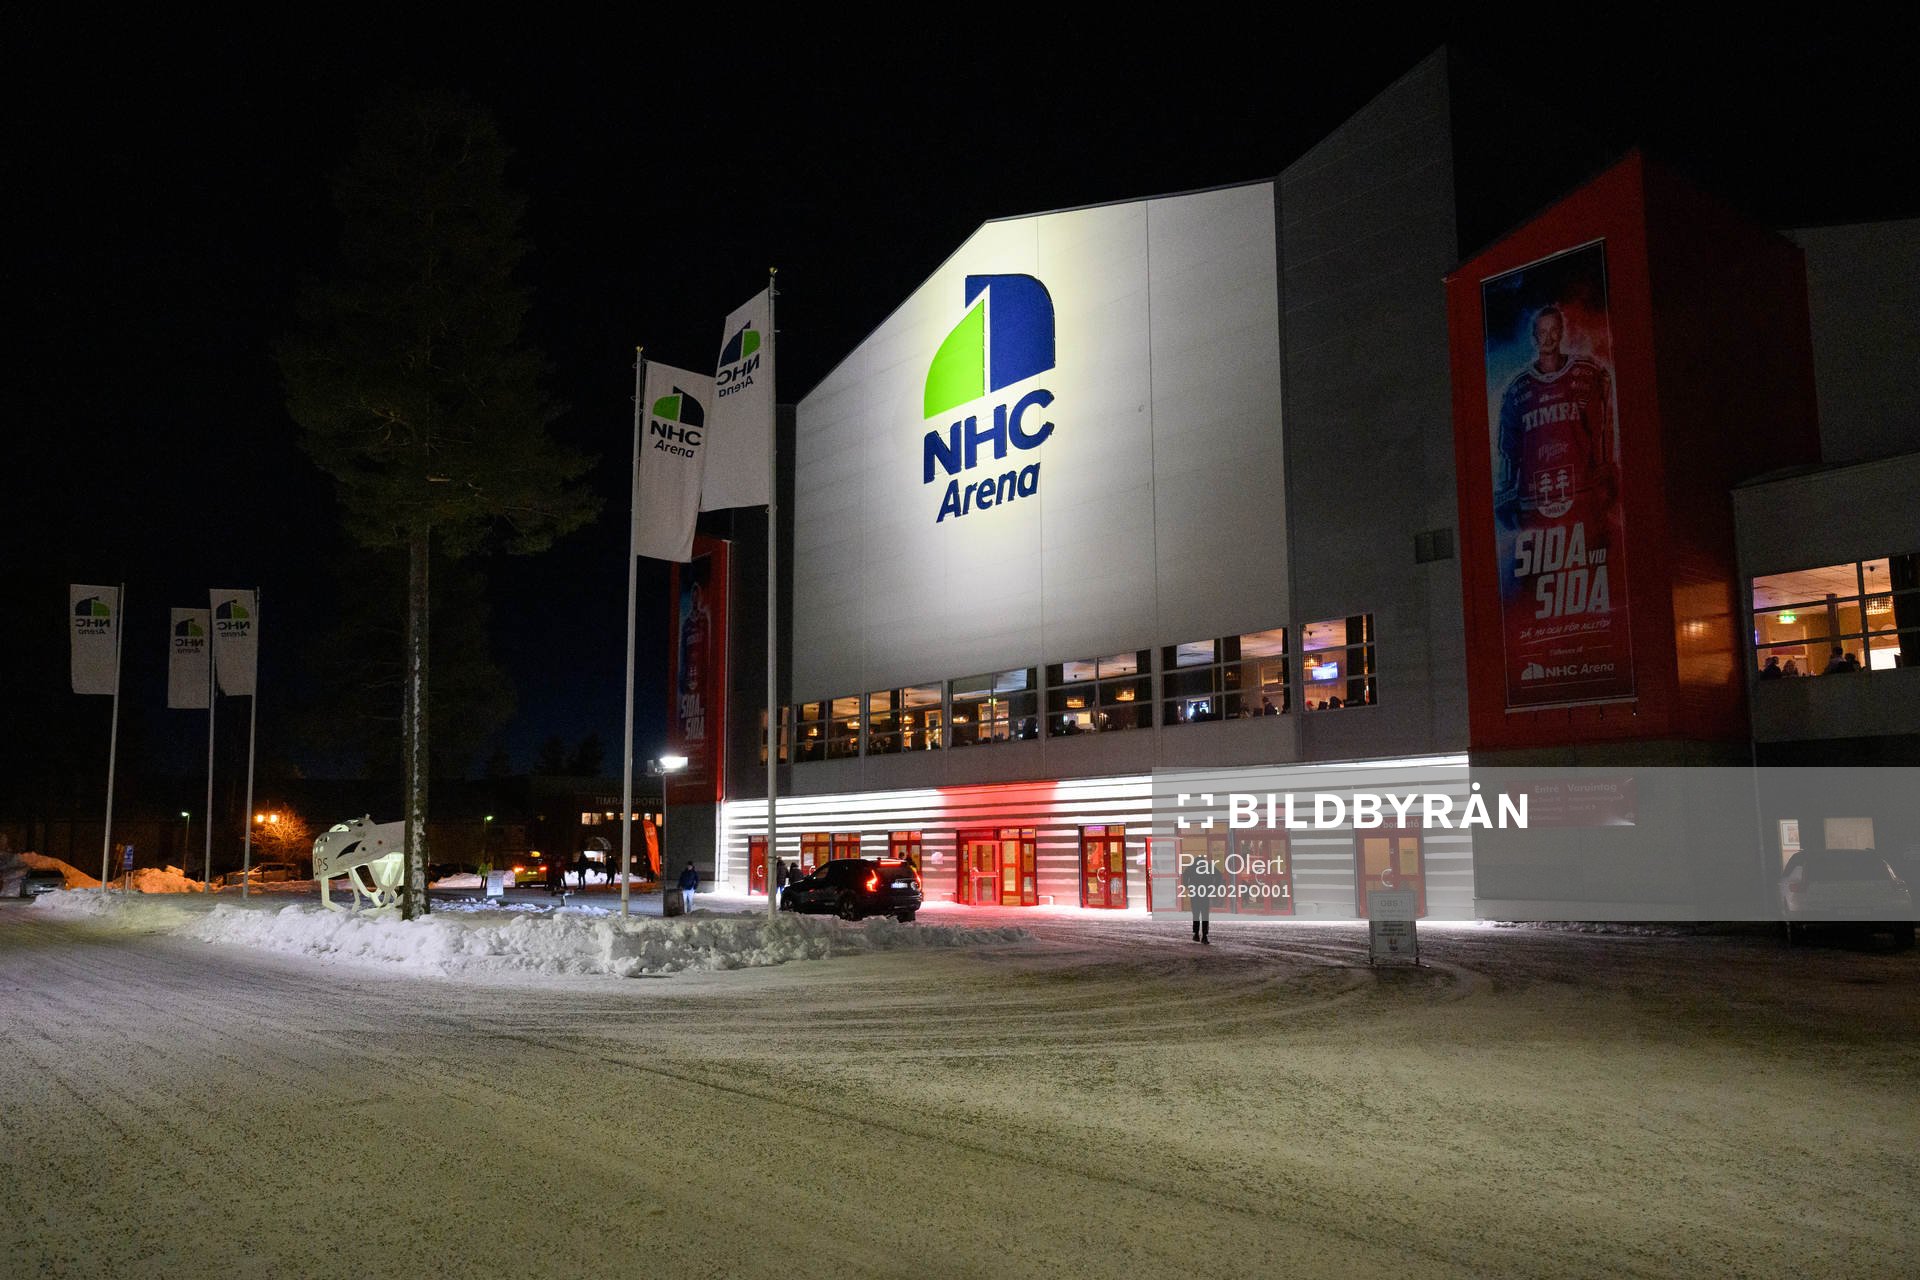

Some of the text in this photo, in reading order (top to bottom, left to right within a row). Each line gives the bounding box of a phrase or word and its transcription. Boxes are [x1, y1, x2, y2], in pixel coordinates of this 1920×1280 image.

[650, 420, 702, 446] NHC
[654, 439, 695, 458] Arena
[923, 388, 1055, 484] NHC
[936, 462, 1041, 523] Arena
[1514, 521, 1607, 577] SIDA VID
[1535, 564, 1610, 619] SIDA
[1545, 663, 1615, 678] NHC Arena
